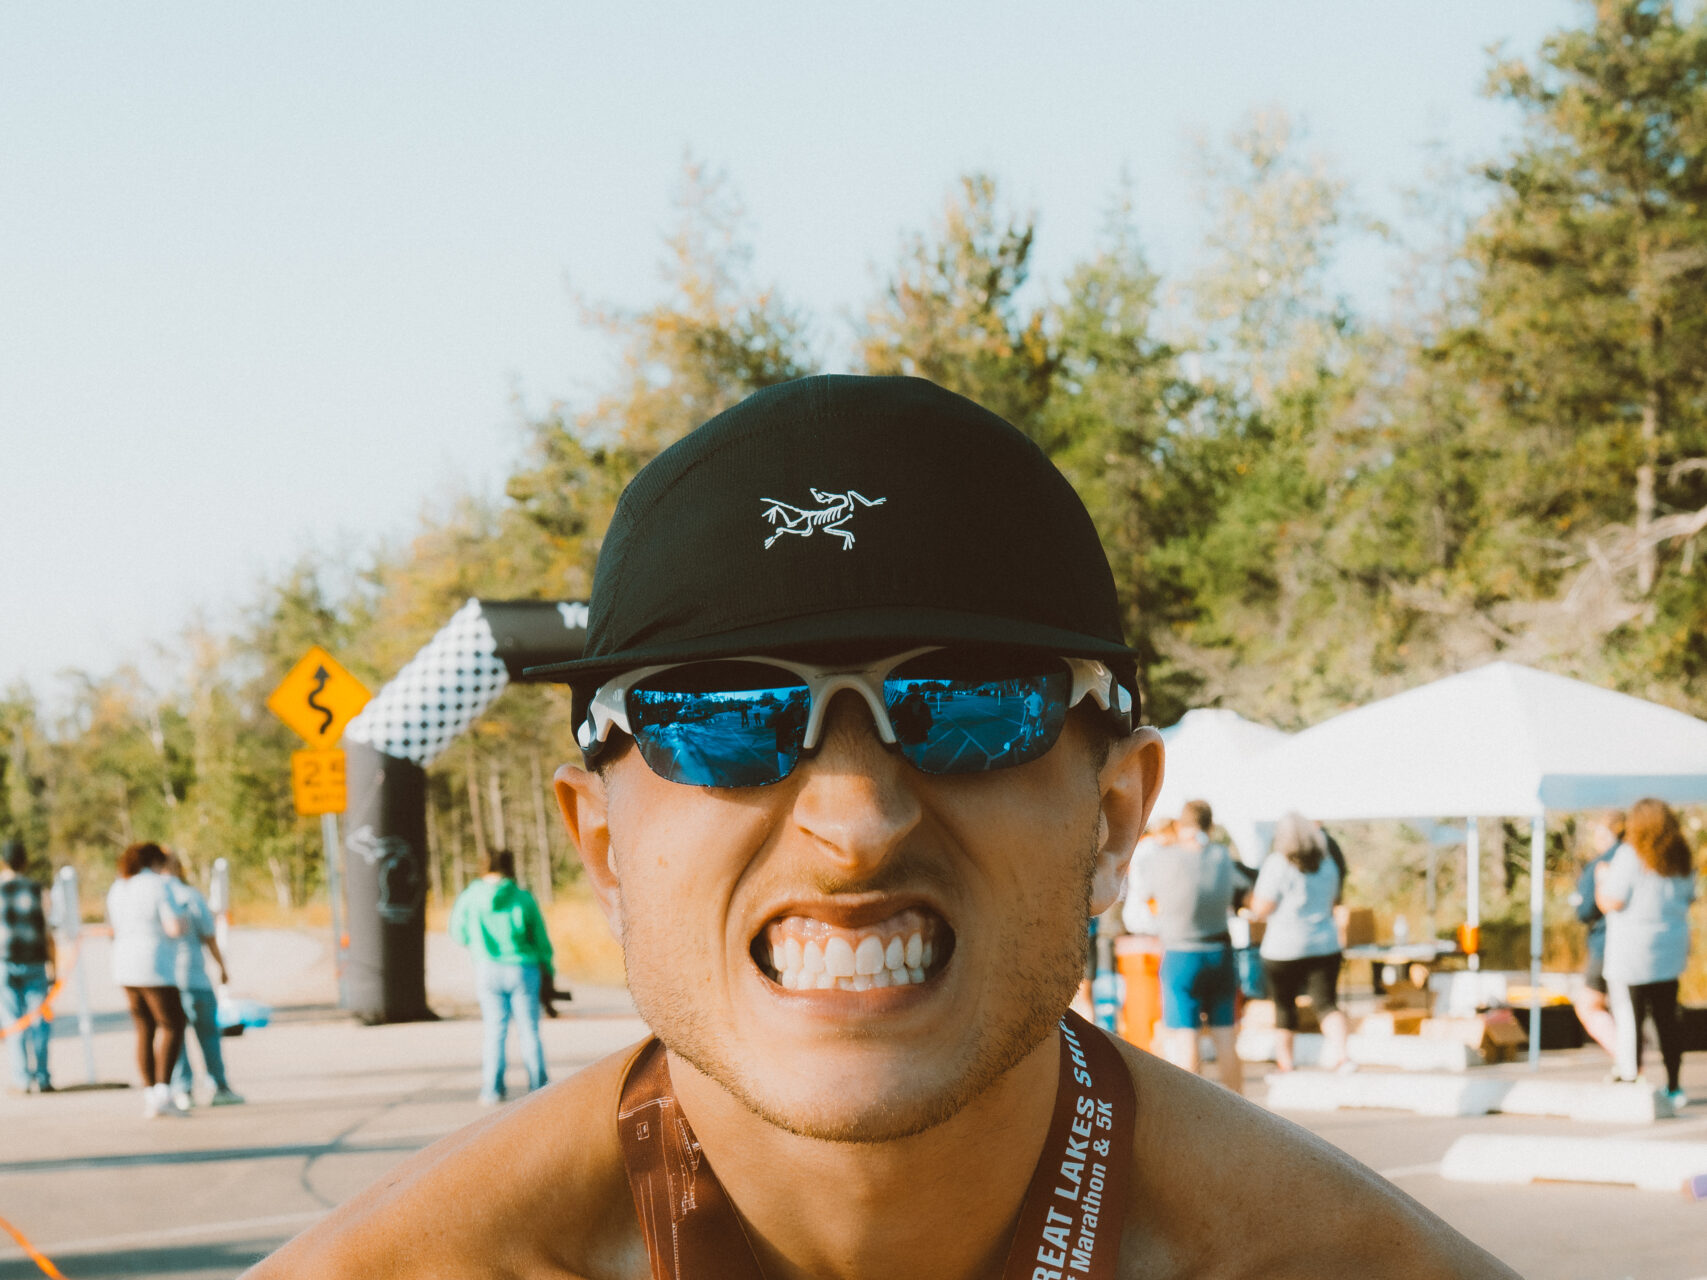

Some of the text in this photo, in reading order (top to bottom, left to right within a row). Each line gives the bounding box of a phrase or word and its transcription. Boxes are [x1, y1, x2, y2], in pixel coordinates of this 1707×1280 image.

[1058, 1015, 1093, 1088] SHIP
[1054, 1095, 1095, 1201] LAKES
[1092, 1138, 1111, 1157] &
[1095, 1098, 1113, 1131] 5K
[1069, 1162, 1107, 1273] Marathon
